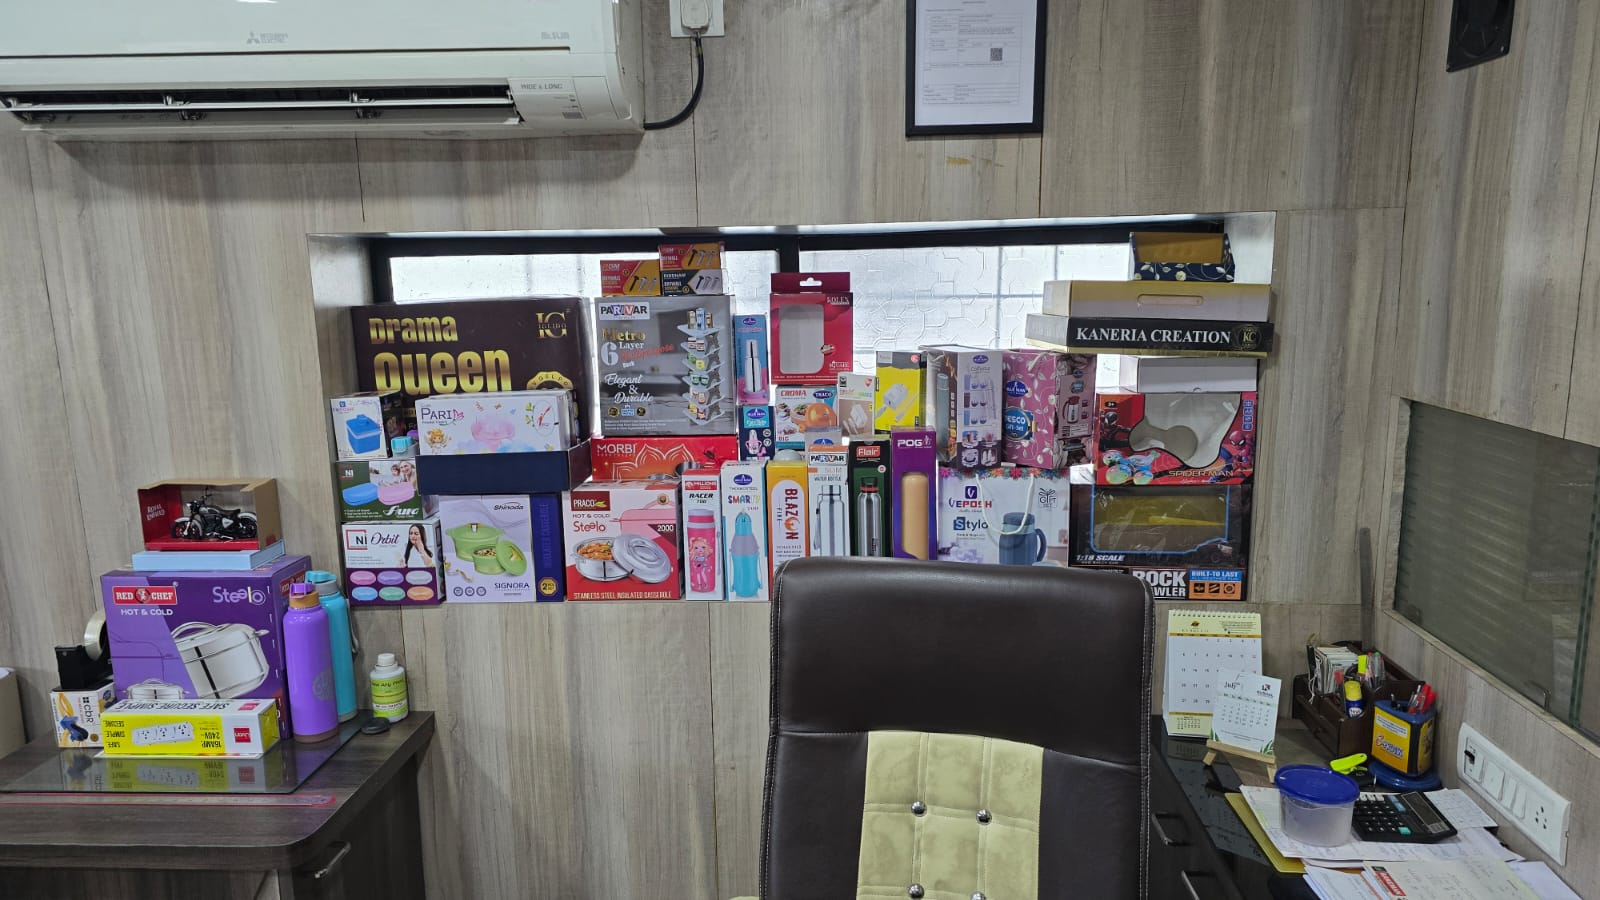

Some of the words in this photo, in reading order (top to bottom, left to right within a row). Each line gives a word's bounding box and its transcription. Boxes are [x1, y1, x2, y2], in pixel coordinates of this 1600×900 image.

[600, 304, 648, 316] PARIVAR
[368, 315, 459, 345] Drama
[602, 328, 646, 341] Metro
[1076, 327, 1147, 342] KANERIA
[1150, 328, 1231, 344] CREATION
[619, 341, 645, 350] Layer
[601, 341, 619, 366] 6
[604, 373, 643, 389] Elegant
[628, 384, 639, 395] &
[614, 391, 654, 404] Durable
[420, 407, 453, 420] PARI
[596, 443, 637, 454] MORBI
[858, 448, 879, 456] Flair
[810, 454, 845, 463] PARIVAR
[573, 499, 595, 508] PRACO
[656, 524, 675, 532] 2000
[954, 518, 989, 532] Stylo
[355, 535, 368, 545] NI
[370, 531, 400, 546] Orbit
[1096, 554, 1126, 562] SCALE
[115, 591, 134, 601] RED
[150, 591, 174, 601] CHEF
[121, 608, 138, 616] HOT
[141, 608, 148, 616] &
[150, 608, 174, 616] COLD
